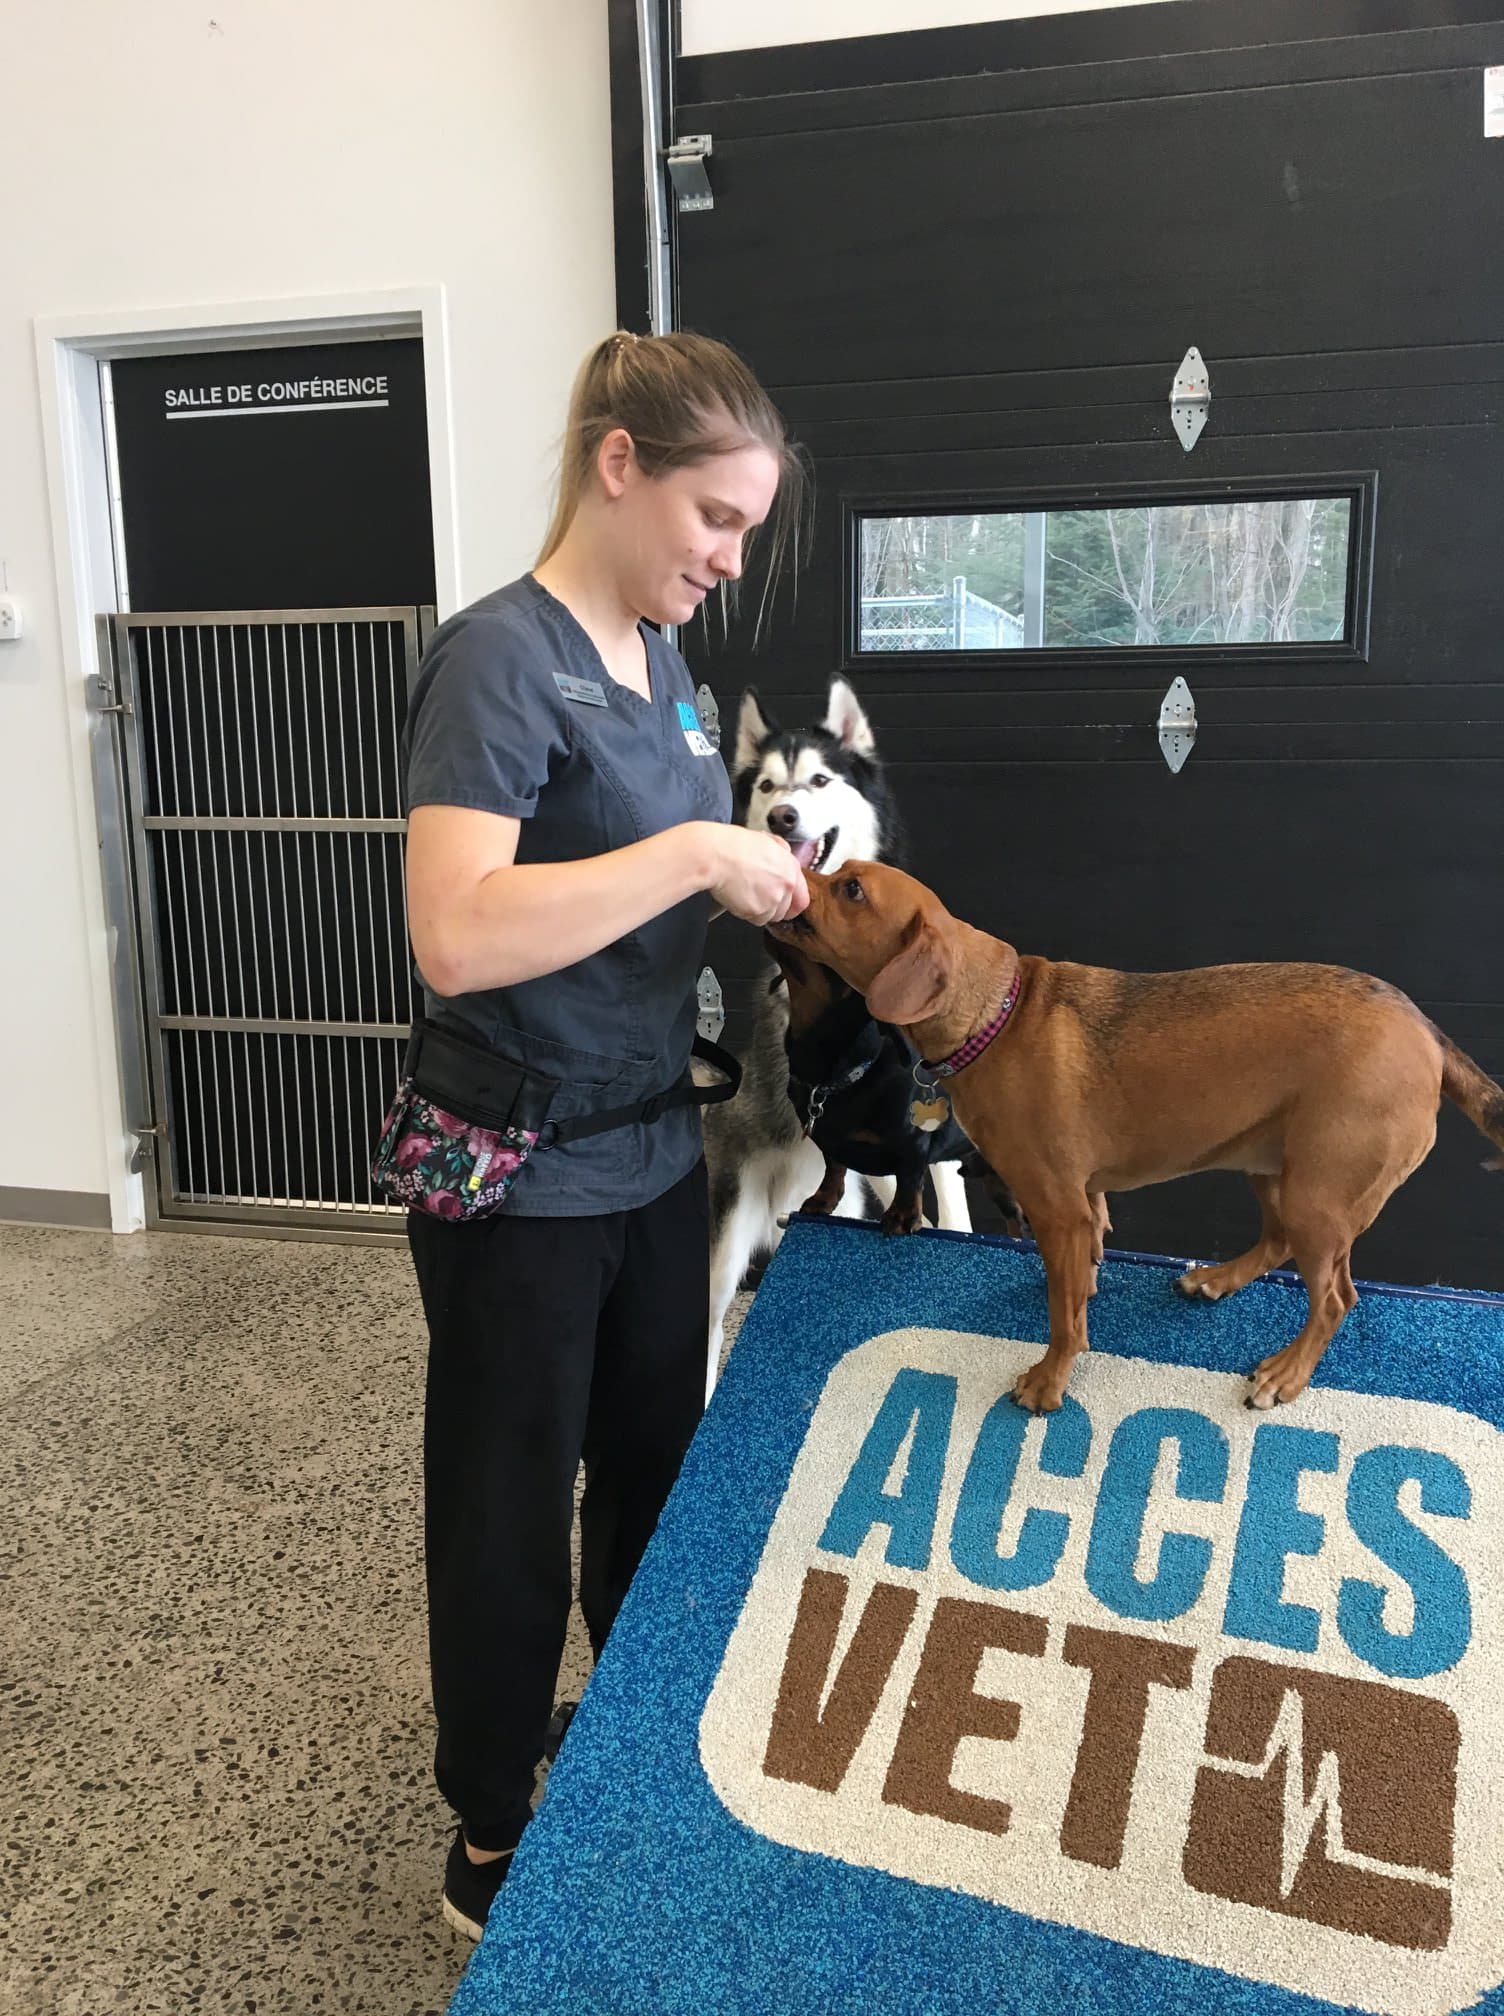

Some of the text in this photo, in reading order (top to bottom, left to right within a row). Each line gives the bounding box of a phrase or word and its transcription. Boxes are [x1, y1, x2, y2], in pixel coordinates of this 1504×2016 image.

[165, 376, 389, 407] SALLE DE CONFÉRENCE
[817, 1367, 1472, 1679] ACCES
[763, 1566, 1198, 1870] VET
